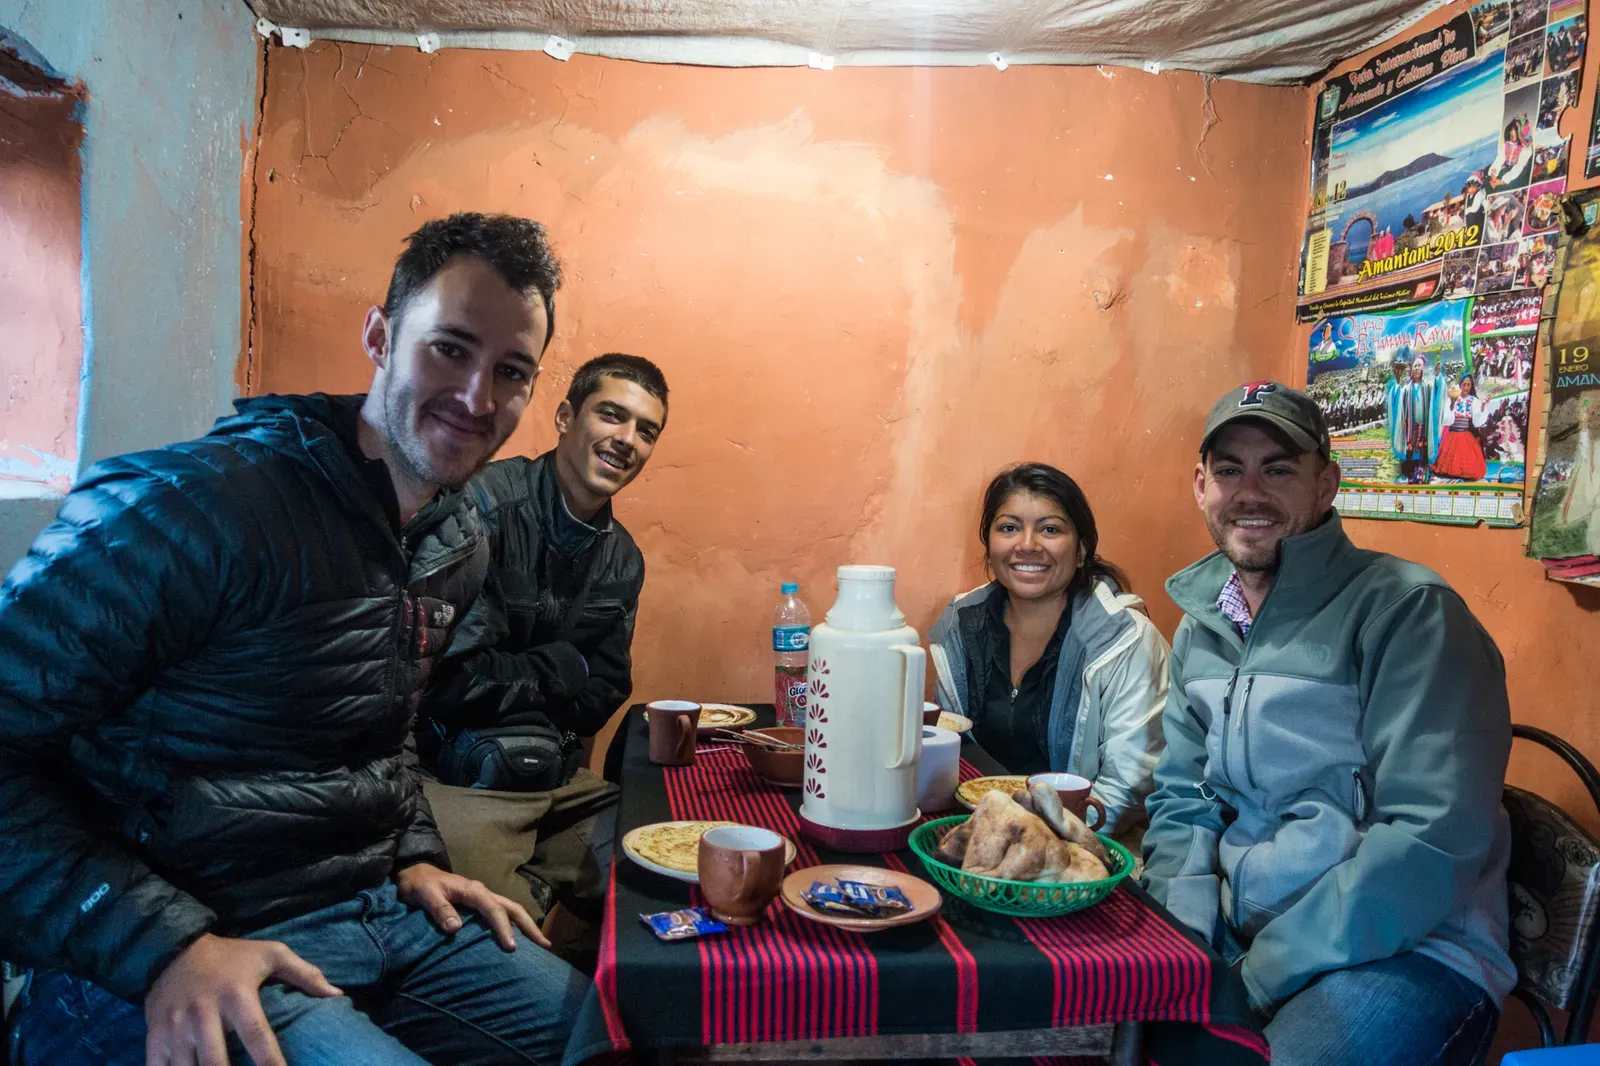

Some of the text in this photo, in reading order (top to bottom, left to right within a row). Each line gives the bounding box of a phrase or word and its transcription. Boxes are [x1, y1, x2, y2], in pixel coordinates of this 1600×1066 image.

[1433, 224, 1479, 256] 2012
[1413, 322, 1455, 348] RAYMI
[1560, 346, 1589, 364] 19
[1558, 364, 1589, 374] ENERO
